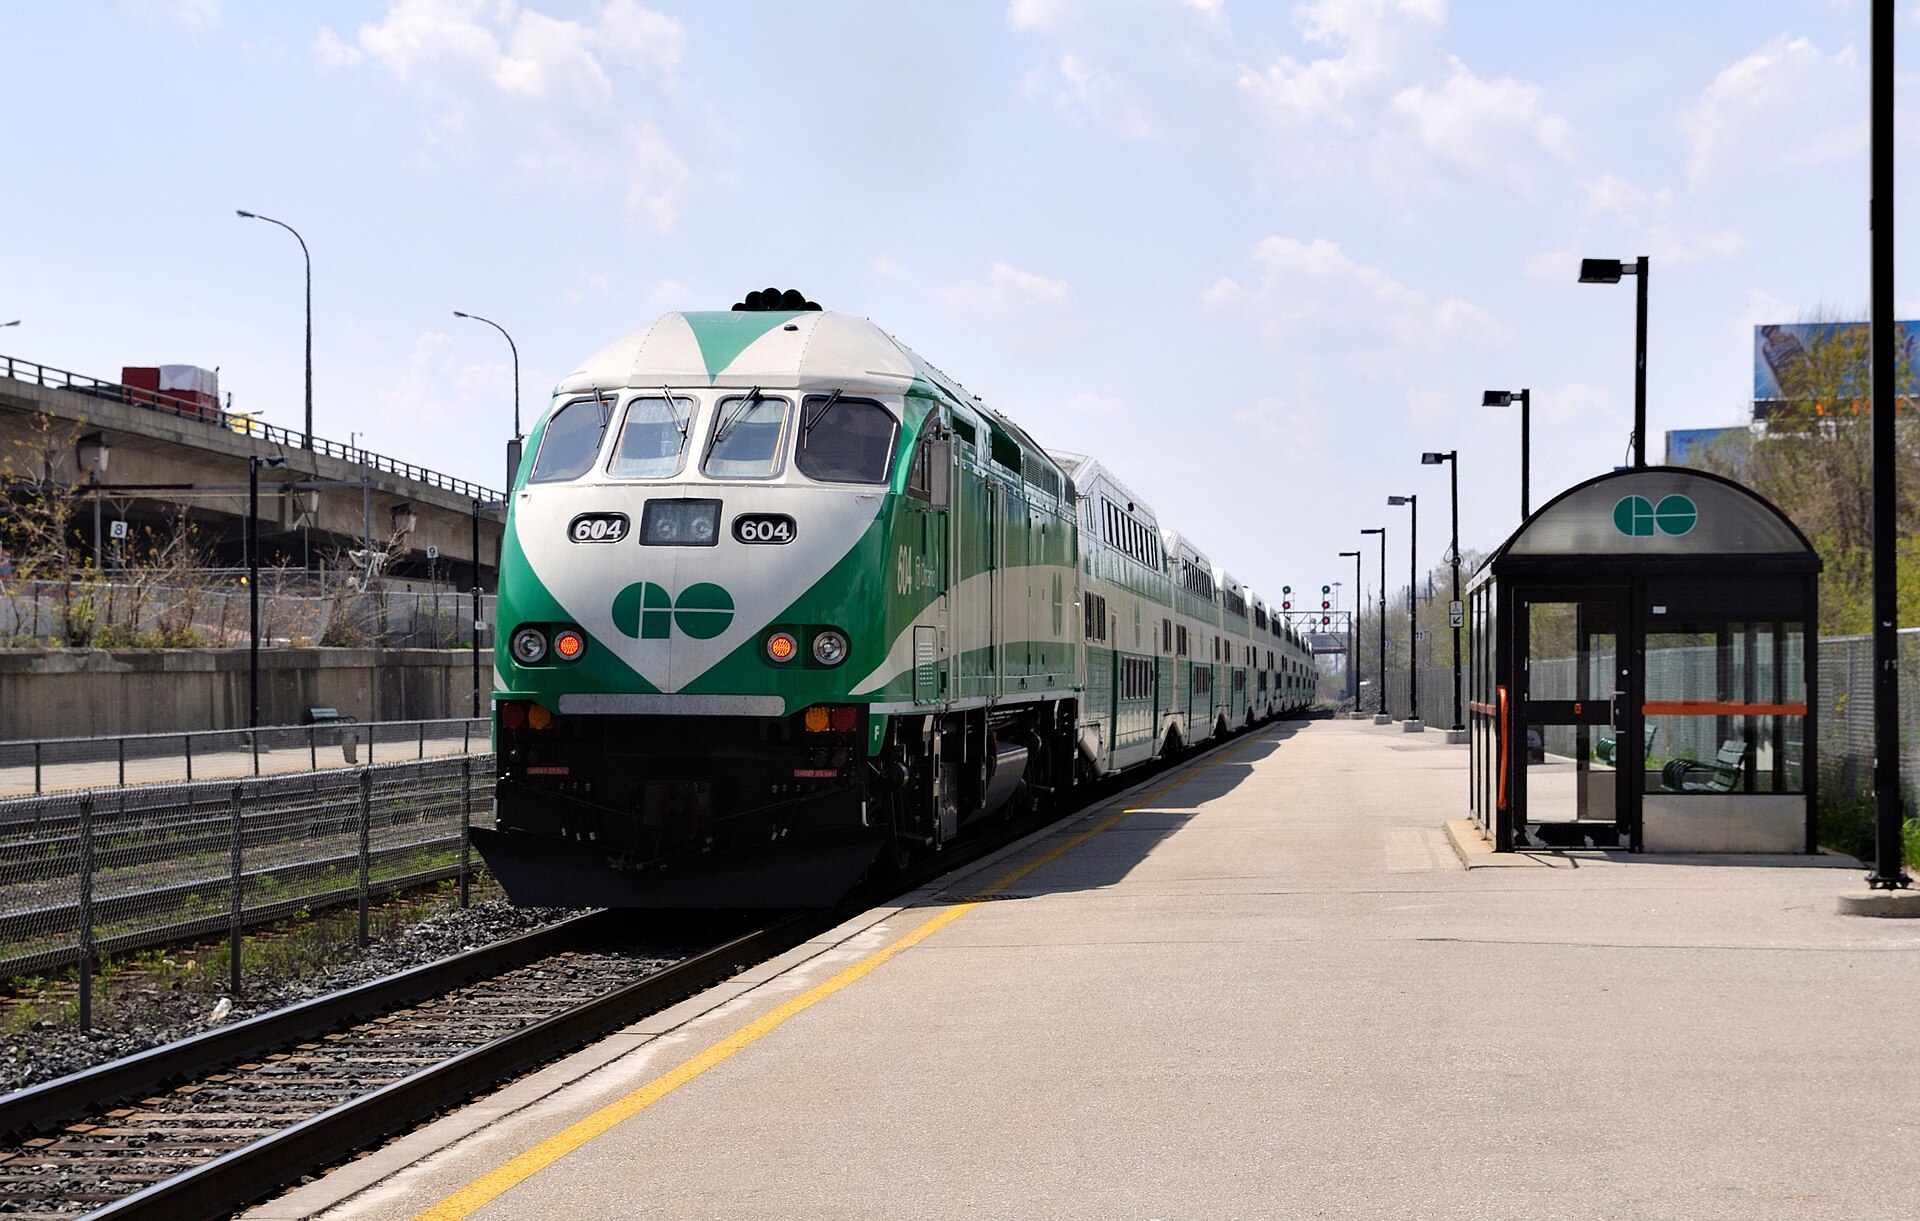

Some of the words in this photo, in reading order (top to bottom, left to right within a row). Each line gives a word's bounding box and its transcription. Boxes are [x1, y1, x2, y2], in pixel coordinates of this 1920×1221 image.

[575, 519, 622, 540] 604
[741, 520, 790, 540] 604
[1612, 494, 1698, 537] GO
[897, 544, 912, 595] 604
[611, 581, 735, 640] GO
[874, 725, 880, 740] F
